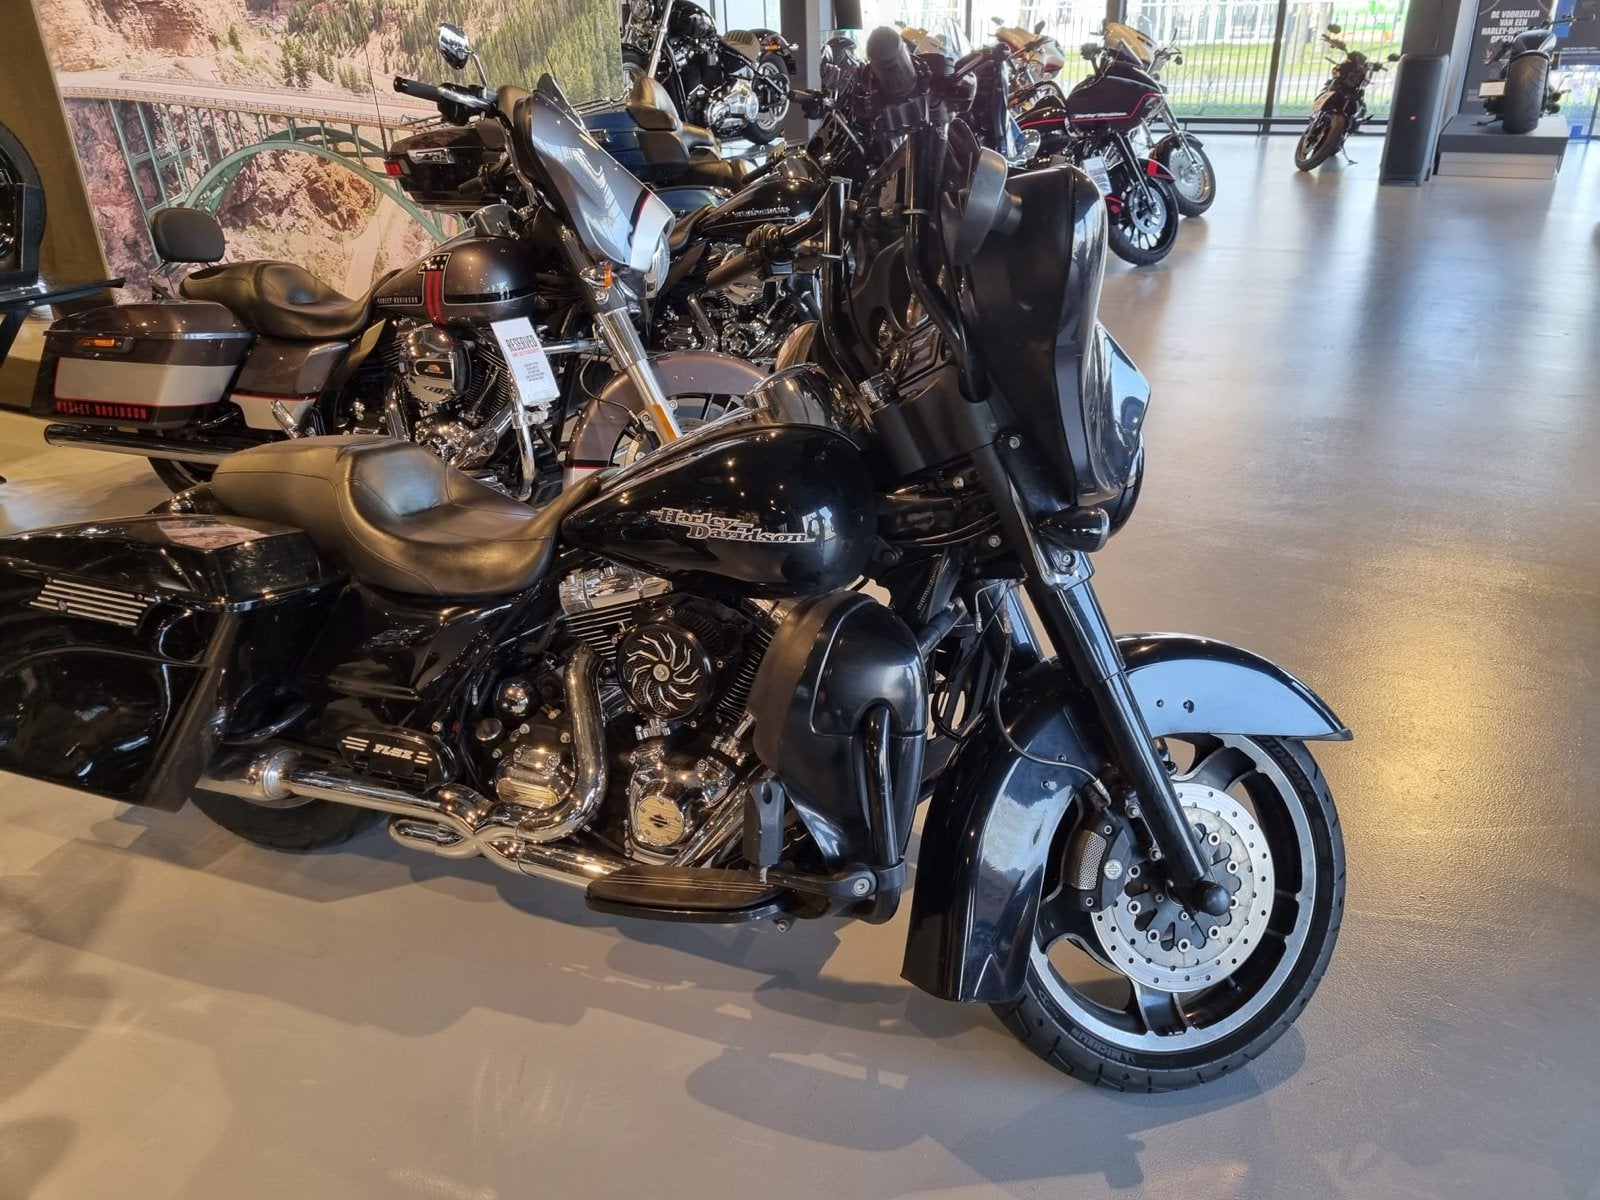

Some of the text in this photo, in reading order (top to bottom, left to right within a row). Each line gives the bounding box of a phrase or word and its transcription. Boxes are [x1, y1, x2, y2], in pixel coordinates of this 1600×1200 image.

[1491, 9, 1540, 18] DE VOORDELEN
[1499, 18, 1528, 26] VAN EEN
[505, 334, 538, 352] RESERVED
[57, 402, 147, 419] HARLEY-DAVIDSON
[686, 525, 817, 543] Davidson
